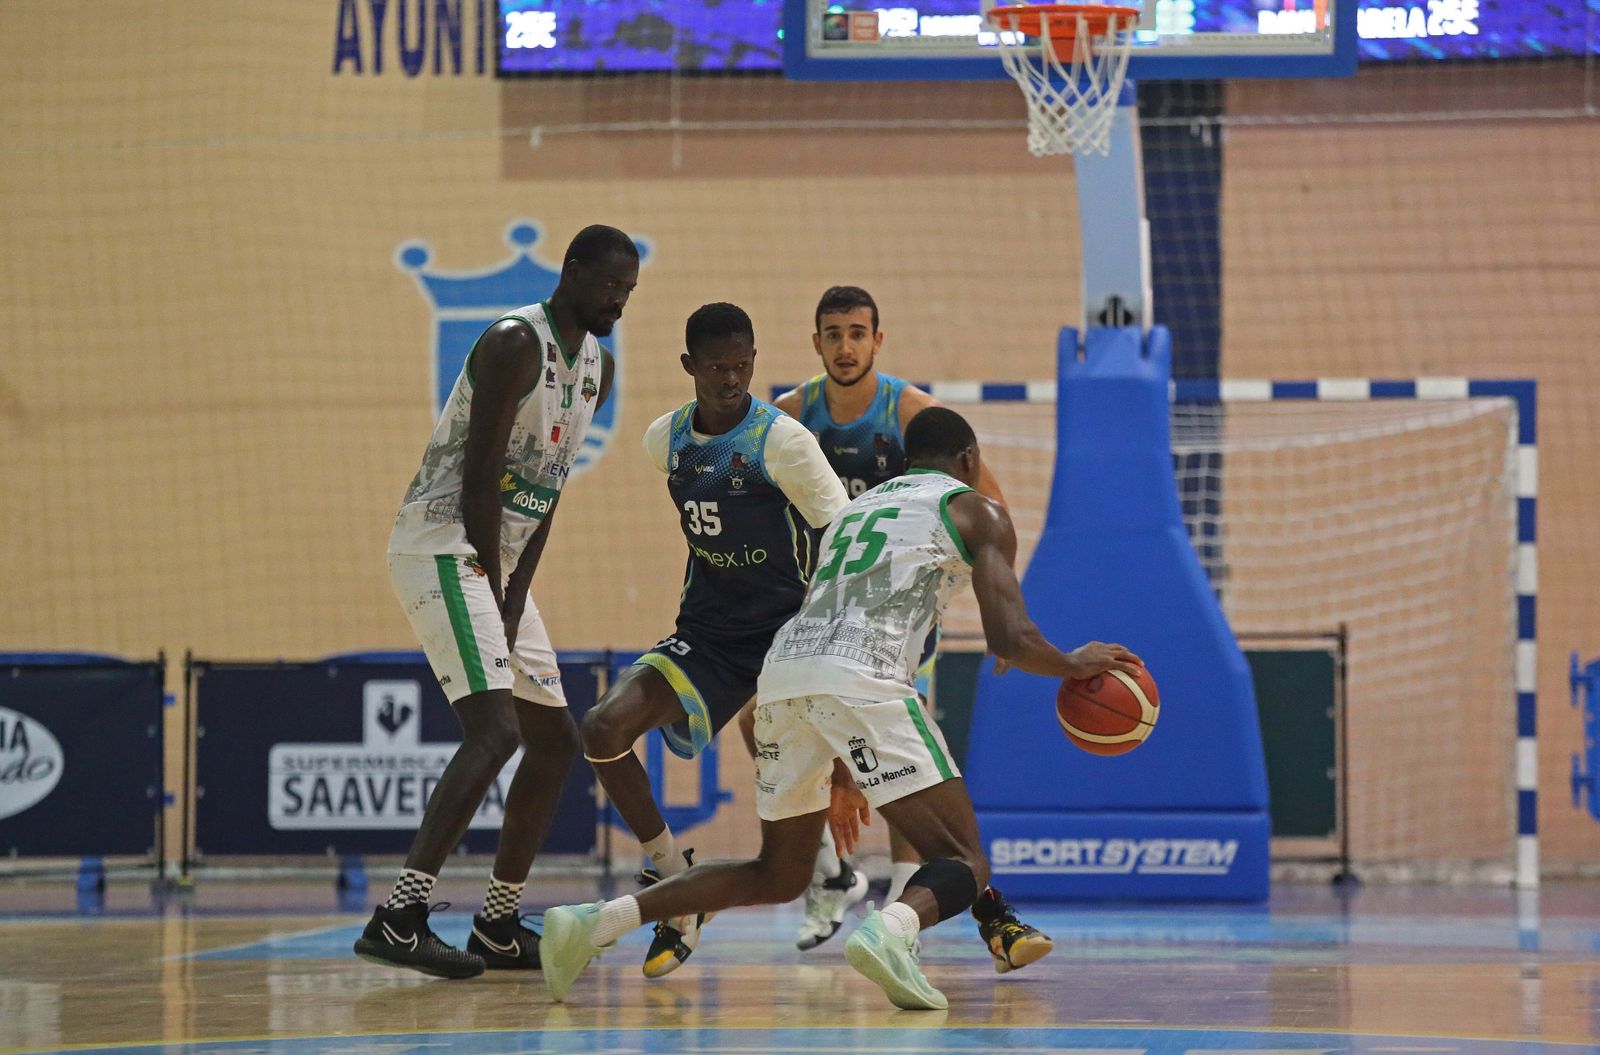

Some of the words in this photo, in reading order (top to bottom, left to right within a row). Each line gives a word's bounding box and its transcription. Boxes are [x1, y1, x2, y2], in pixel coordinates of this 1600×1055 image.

[684, 500, 722, 537] 35
[815, 507, 902, 582] 55
[880, 765, 917, 782] Mancha
[283, 775, 506, 818] SAAVEA
